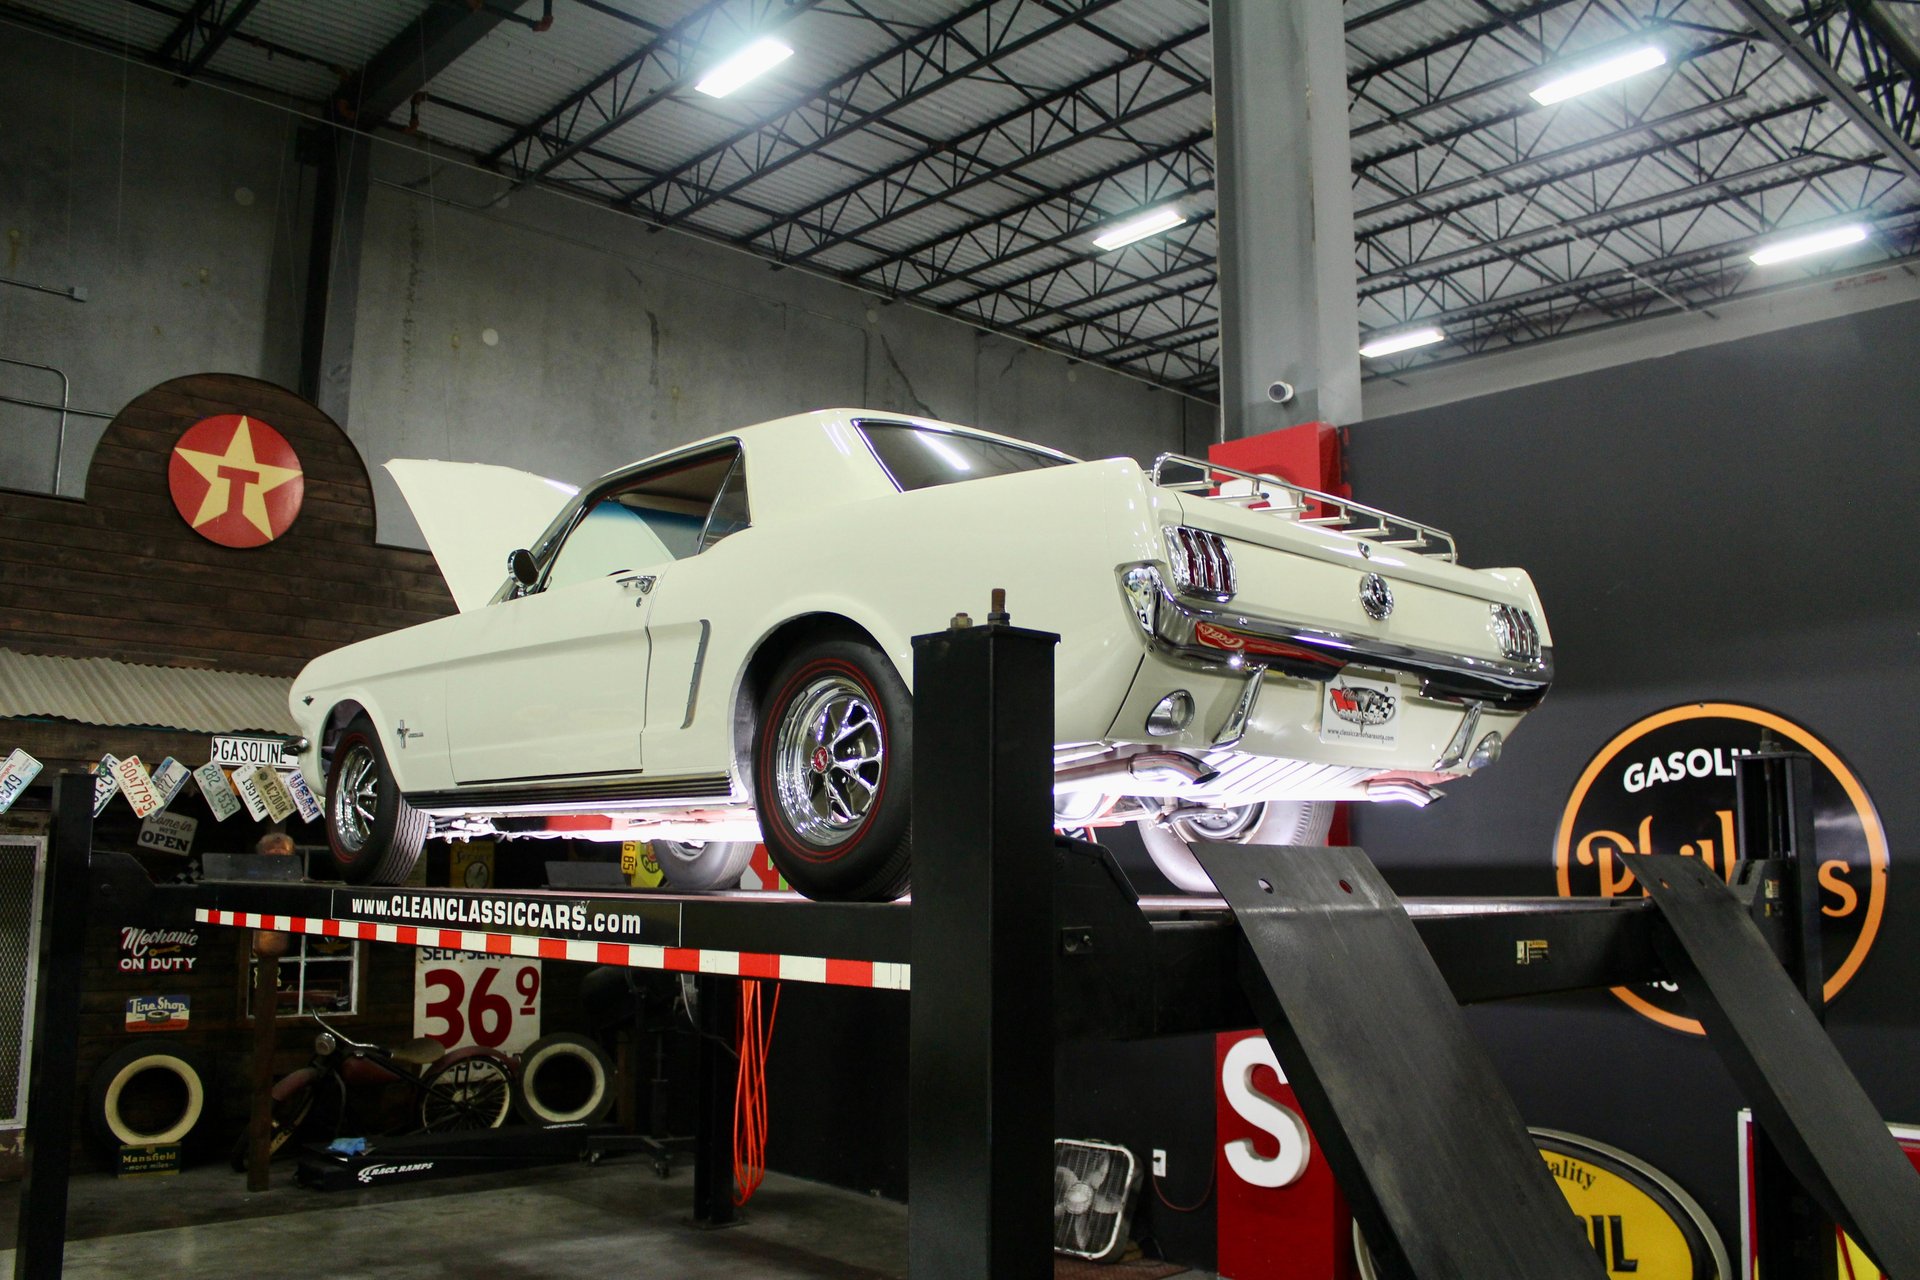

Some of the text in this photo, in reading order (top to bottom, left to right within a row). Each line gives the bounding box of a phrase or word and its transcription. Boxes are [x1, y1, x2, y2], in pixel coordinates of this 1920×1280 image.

[221, 740, 287, 764] GASOLINE
[1623, 747, 1761, 793] GASOLI
[119, 761, 157, 812] 80A7795
[202, 764, 237, 816] 282 1533
[141, 830, 190, 852] OPEN
[351, 895, 641, 935] www.CLEANCLASSICCARS.com
[122, 926, 199, 957] Mechanic
[120, 957, 197, 970] ON DUTY
[129, 996, 187, 1014] Tire Shop
[122, 1152, 176, 1163] Mansfield
[371, 1162, 434, 1176] RACE RAMPS
[1547, 1159, 1597, 1191] ality
